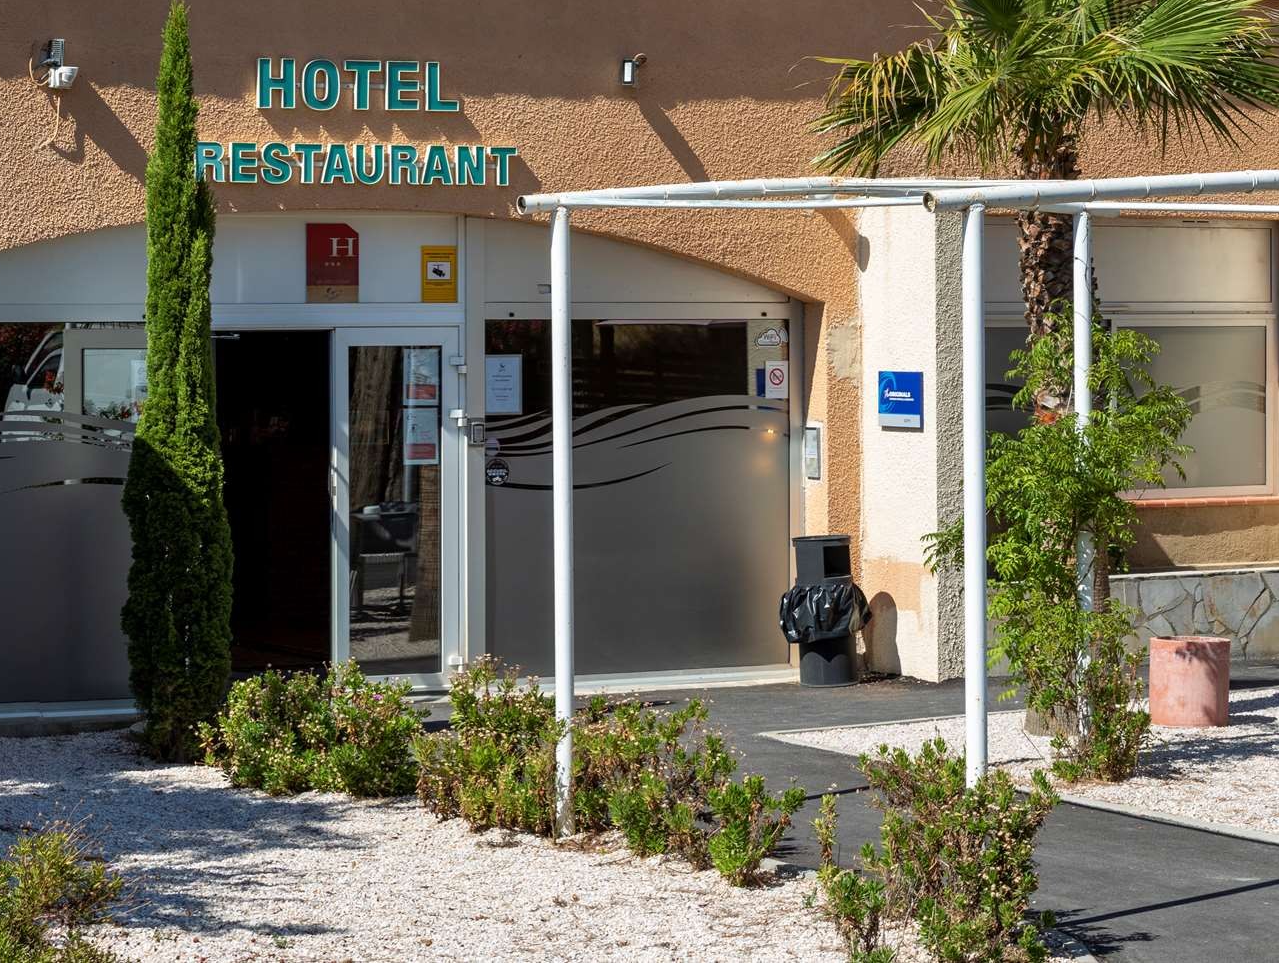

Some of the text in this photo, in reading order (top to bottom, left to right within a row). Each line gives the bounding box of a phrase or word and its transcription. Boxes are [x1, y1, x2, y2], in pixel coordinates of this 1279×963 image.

[256, 57, 460, 112] HOTEL
[195, 141, 517, 186] RESTAURANT
[328, 237, 358, 257] H
